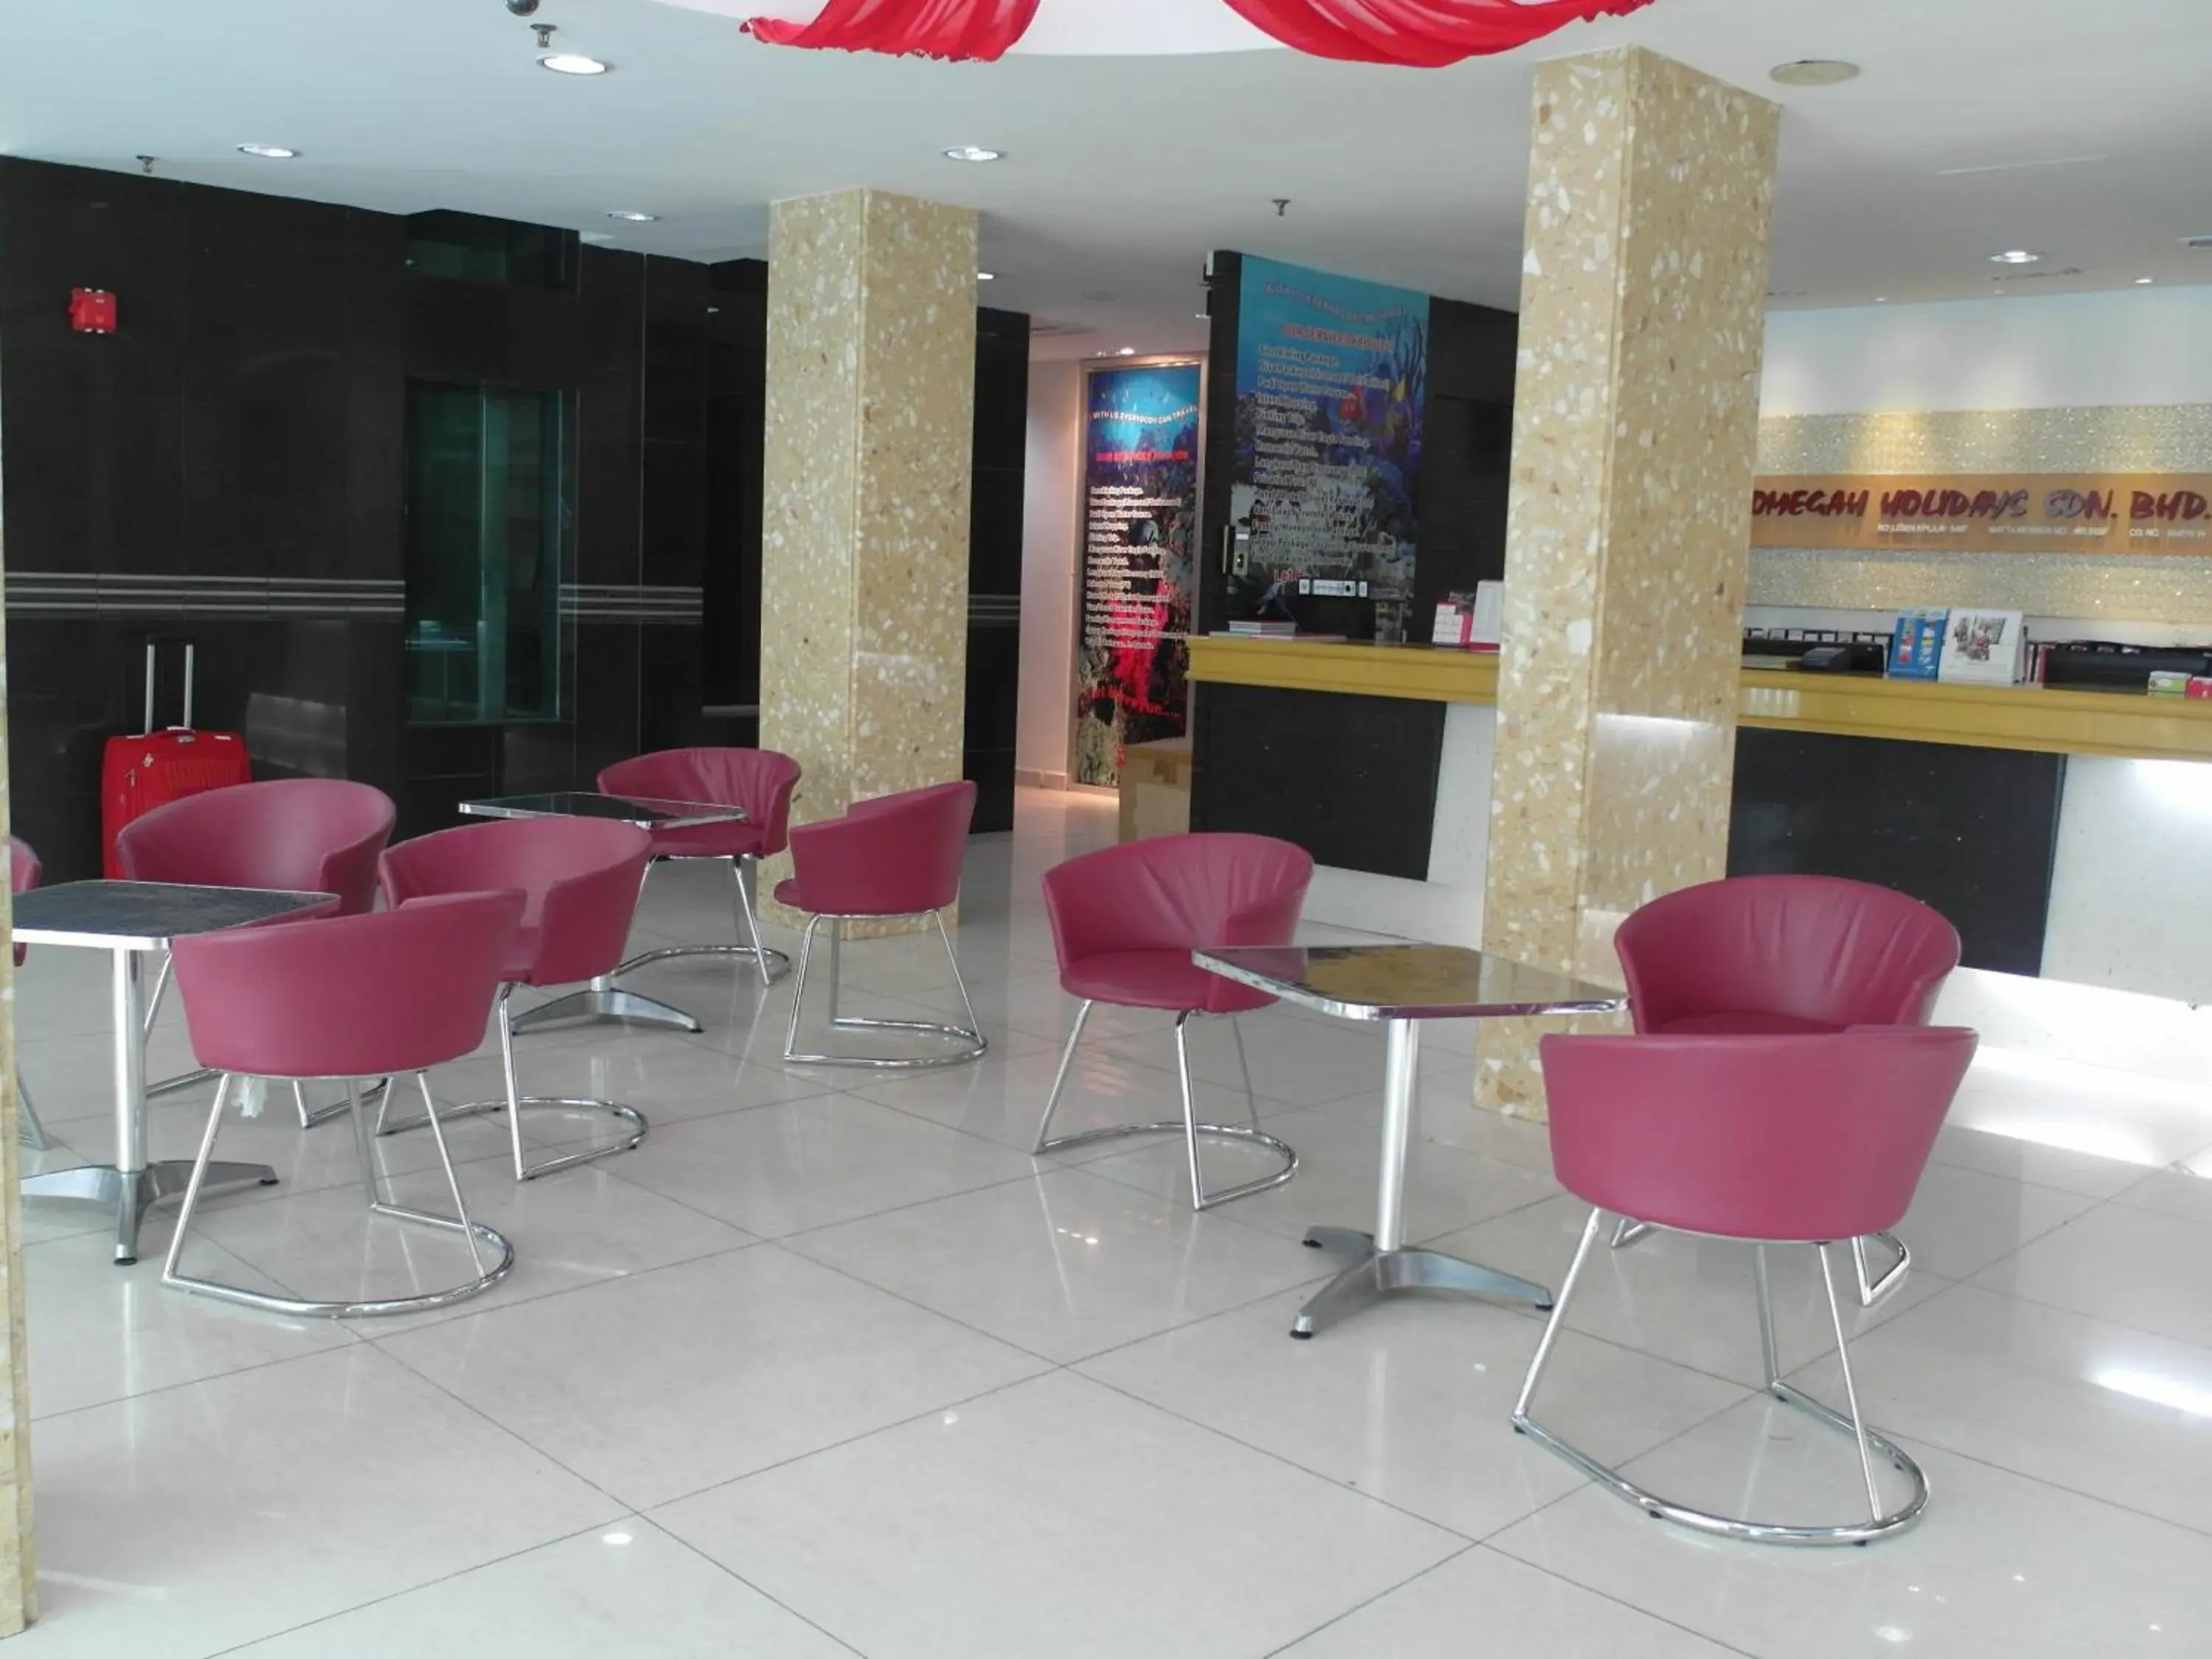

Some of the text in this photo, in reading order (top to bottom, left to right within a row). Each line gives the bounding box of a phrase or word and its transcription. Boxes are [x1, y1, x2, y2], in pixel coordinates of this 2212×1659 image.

[1752, 488, 2211, 521] OMEGAH HOLIDAYS SDN. BHD.
